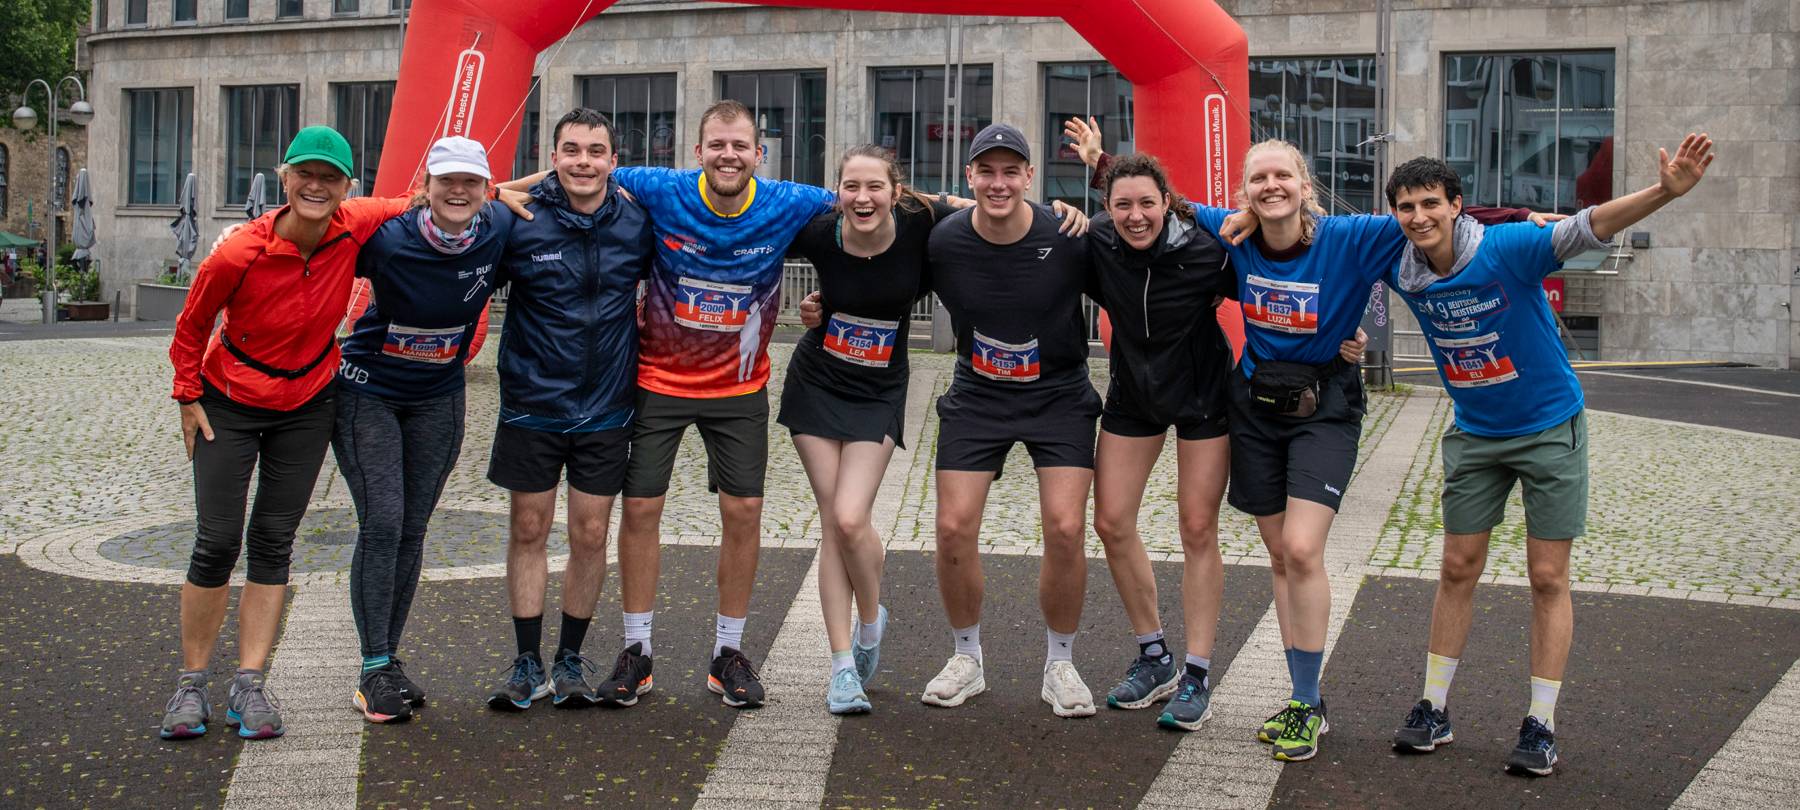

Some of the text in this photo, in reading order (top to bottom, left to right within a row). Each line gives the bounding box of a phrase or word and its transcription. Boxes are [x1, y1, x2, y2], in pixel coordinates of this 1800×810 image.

[454, 61, 476, 133] die beste Musik.
[1212, 104, 1221, 132] Musik.
[1213, 132, 1221, 157] beste
[1213, 158, 1221, 171] die
[531, 251, 562, 262] hummel
[733, 247, 766, 256] CRAFT
[700, 303, 725, 313] 2000
[1268, 303, 1291, 315] 1837
[1447, 297, 1479, 310] DEUTSCHE
[1451, 298, 1502, 318] MEISTERSCHAFT
[699, 313, 724, 323] FELIX
[1267, 314, 1292, 325] LUZIA
[849, 338, 872, 348] 2154
[402, 348, 441, 358] HANNAH
[849, 348, 866, 357] LEA
[993, 359, 1016, 369] 2153
[1460, 360, 1483, 370] 1841
[339, 358, 369, 385] RUB
[996, 368, 1012, 376] TIM
